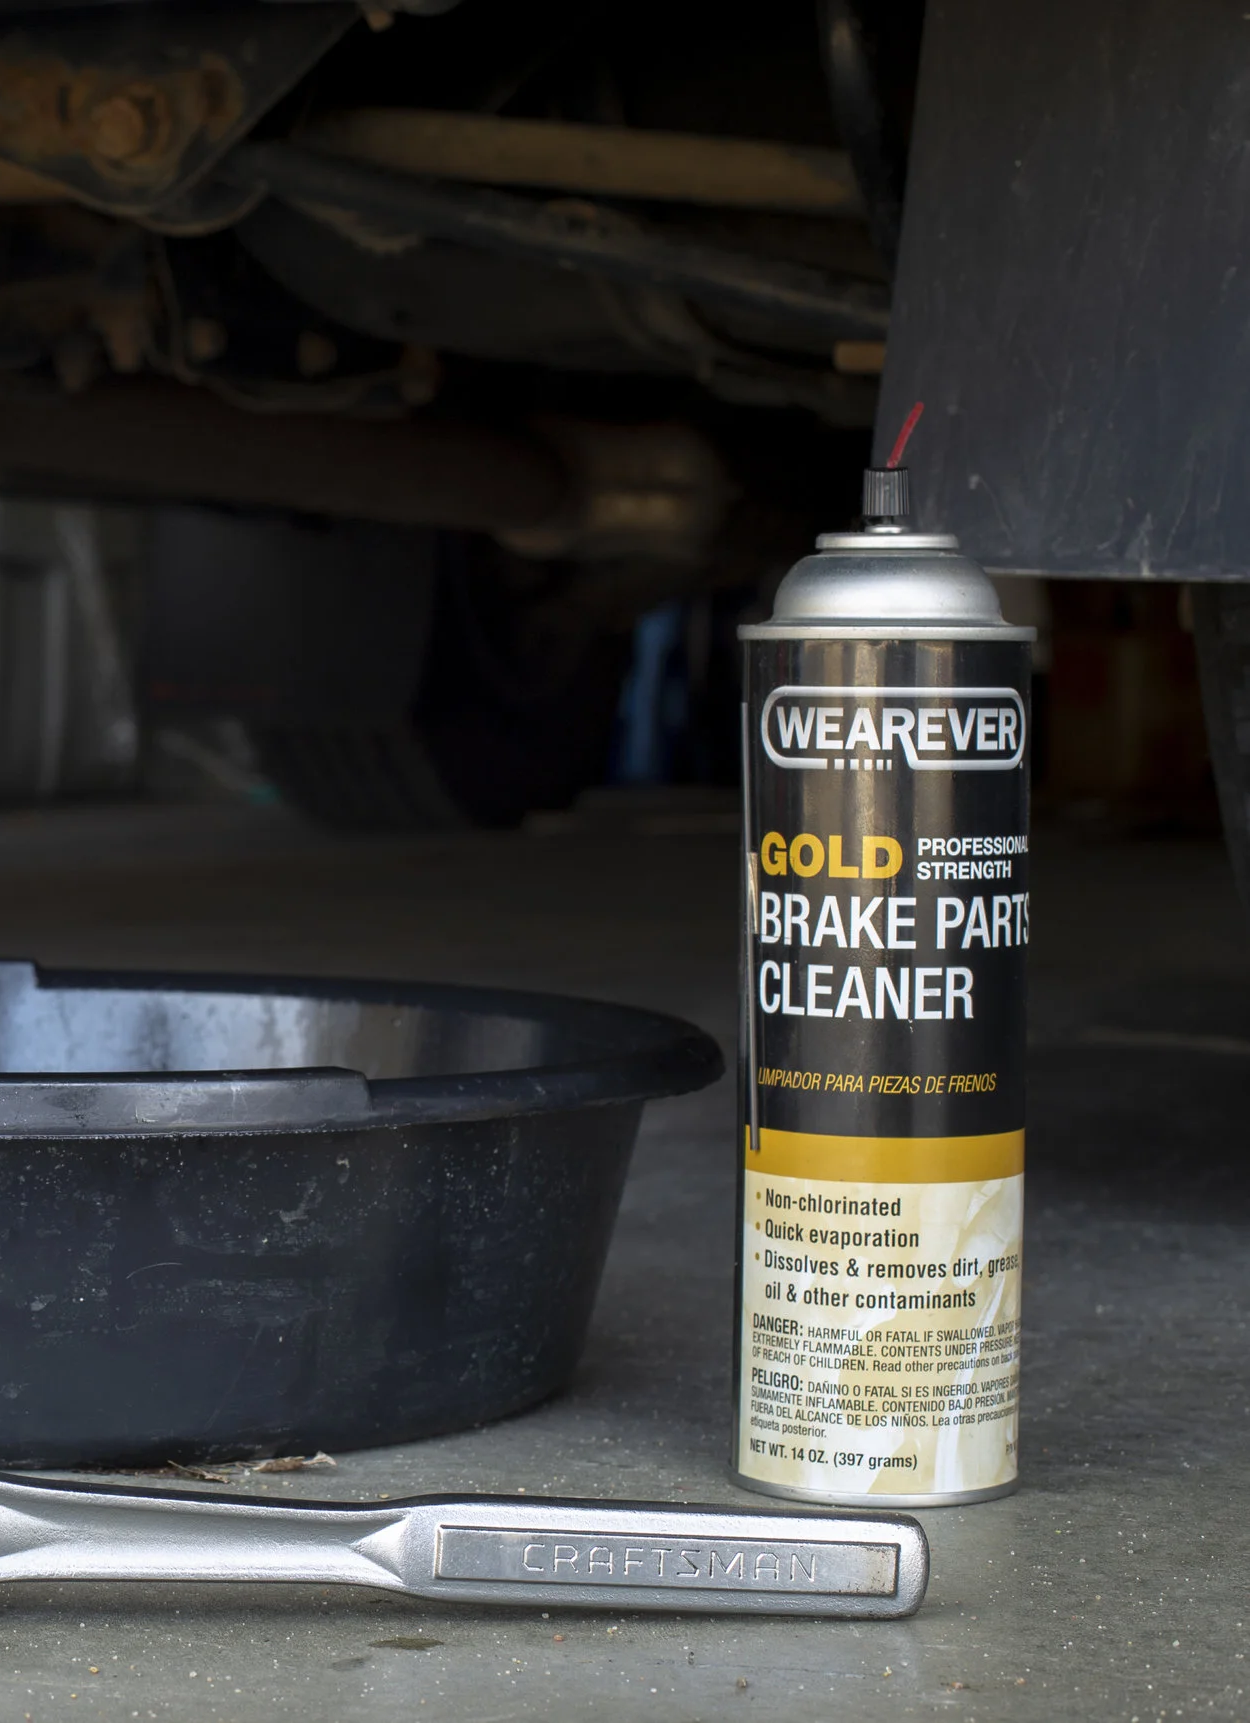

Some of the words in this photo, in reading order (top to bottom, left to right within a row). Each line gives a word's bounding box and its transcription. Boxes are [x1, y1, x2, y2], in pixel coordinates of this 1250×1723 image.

[775, 706, 1019, 751] WEAREVER
[760, 831, 903, 880] GOLD
[917, 834, 1029, 856] PROFESSIONAL
[916, 860, 1012, 880] STRENGTH
[760, 891, 917, 950] BRAKE
[759, 959, 975, 1020] CLEANER
[757, 1067, 821, 1091] LIMPIADOR
[824, 1072, 864, 1093] PARA
[868, 1075, 921, 1094] PIEZAS
[924, 1076, 944, 1094] DE
[947, 1073, 997, 1093] FRENOS
[765, 1188, 901, 1217] Non-chlorinated
[765, 1219, 804, 1243] Quick
[809, 1228, 920, 1250] evaporation
[764, 1249, 840, 1277] Dissolves
[846, 1258, 859, 1278] &
[867, 1260, 947, 1279] removes
[952, 1258, 983, 1278] dirt,
[765, 1282, 781, 1300] oil
[786, 1284, 797, 1302] &
[803, 1287, 849, 1308] other
[855, 1289, 976, 1310] contaminants
[752, 1312, 804, 1337] DANGER:
[807, 1326, 863, 1342] HARMFUL
[866, 1330, 882, 1342] OR
[885, 1330, 921, 1343] FATAL
[923, 1330, 934, 1343] IF
[936, 1325, 996, 1343] SWALLOWED.
[752, 1331, 800, 1351] EXTREMELY
[803, 1340, 877, 1358] FLAMMABLE.
[881, 1344, 942, 1358] CONTENTS
[944, 1342, 977, 1357] UNDER
[752, 1345, 762, 1358] OF
[762, 1348, 791, 1365] REACH
[793, 1353, 807, 1366] OF
[809, 1355, 869, 1372] CHILDREN.
[872, 1359, 902, 1372] Read
[905, 1360, 935, 1372] other
[936, 1356, 990, 1374] precautions
[991, 1355, 1000, 1366] on
[751, 1367, 804, 1392] PELIGRO:
[807, 1380, 849, 1397] DAÑINO
[852, 1384, 861, 1397] O
[864, 1385, 898, 1398] FATAL
[901, 1386, 912, 1398] SI
[915, 1386, 930, 1398] ES
[932, 1382, 979, 1397] INGERIDO.
[981, 1376, 1010, 1393] VAPORES
[750, 1385, 803, 1406] SUMAMENTE
[805, 1395, 878, 1412] INFLAMABLE.
[882, 1399, 946, 1413] CONTENIDO
[948, 1397, 973, 1411] BAJO
[750, 1399, 775, 1416] FUERA
[776, 1405, 793, 1420] DEL
[794, 1409, 844, 1425] ALCANCE
[846, 1414, 862, 1426] DE
[865, 1414, 888, 1427] LOS
[891, 1413, 929, 1427] NIÑOS.
[932, 1415, 951, 1426] Lea
[953, 1413, 976, 1425] otras
[750, 1415, 780, 1432] etiqueta
[782, 1422, 827, 1438] posterior.
[749, 1437, 767, 1454] NET
[768, 1441, 788, 1459] WT.
[791, 1446, 805, 1461] 14
[808, 1448, 829, 1464] OZ.
[833, 1451, 864, 1468] (397
[868, 1453, 918, 1471] grams)
[521, 1542, 817, 1583] CRAFTSMAN
